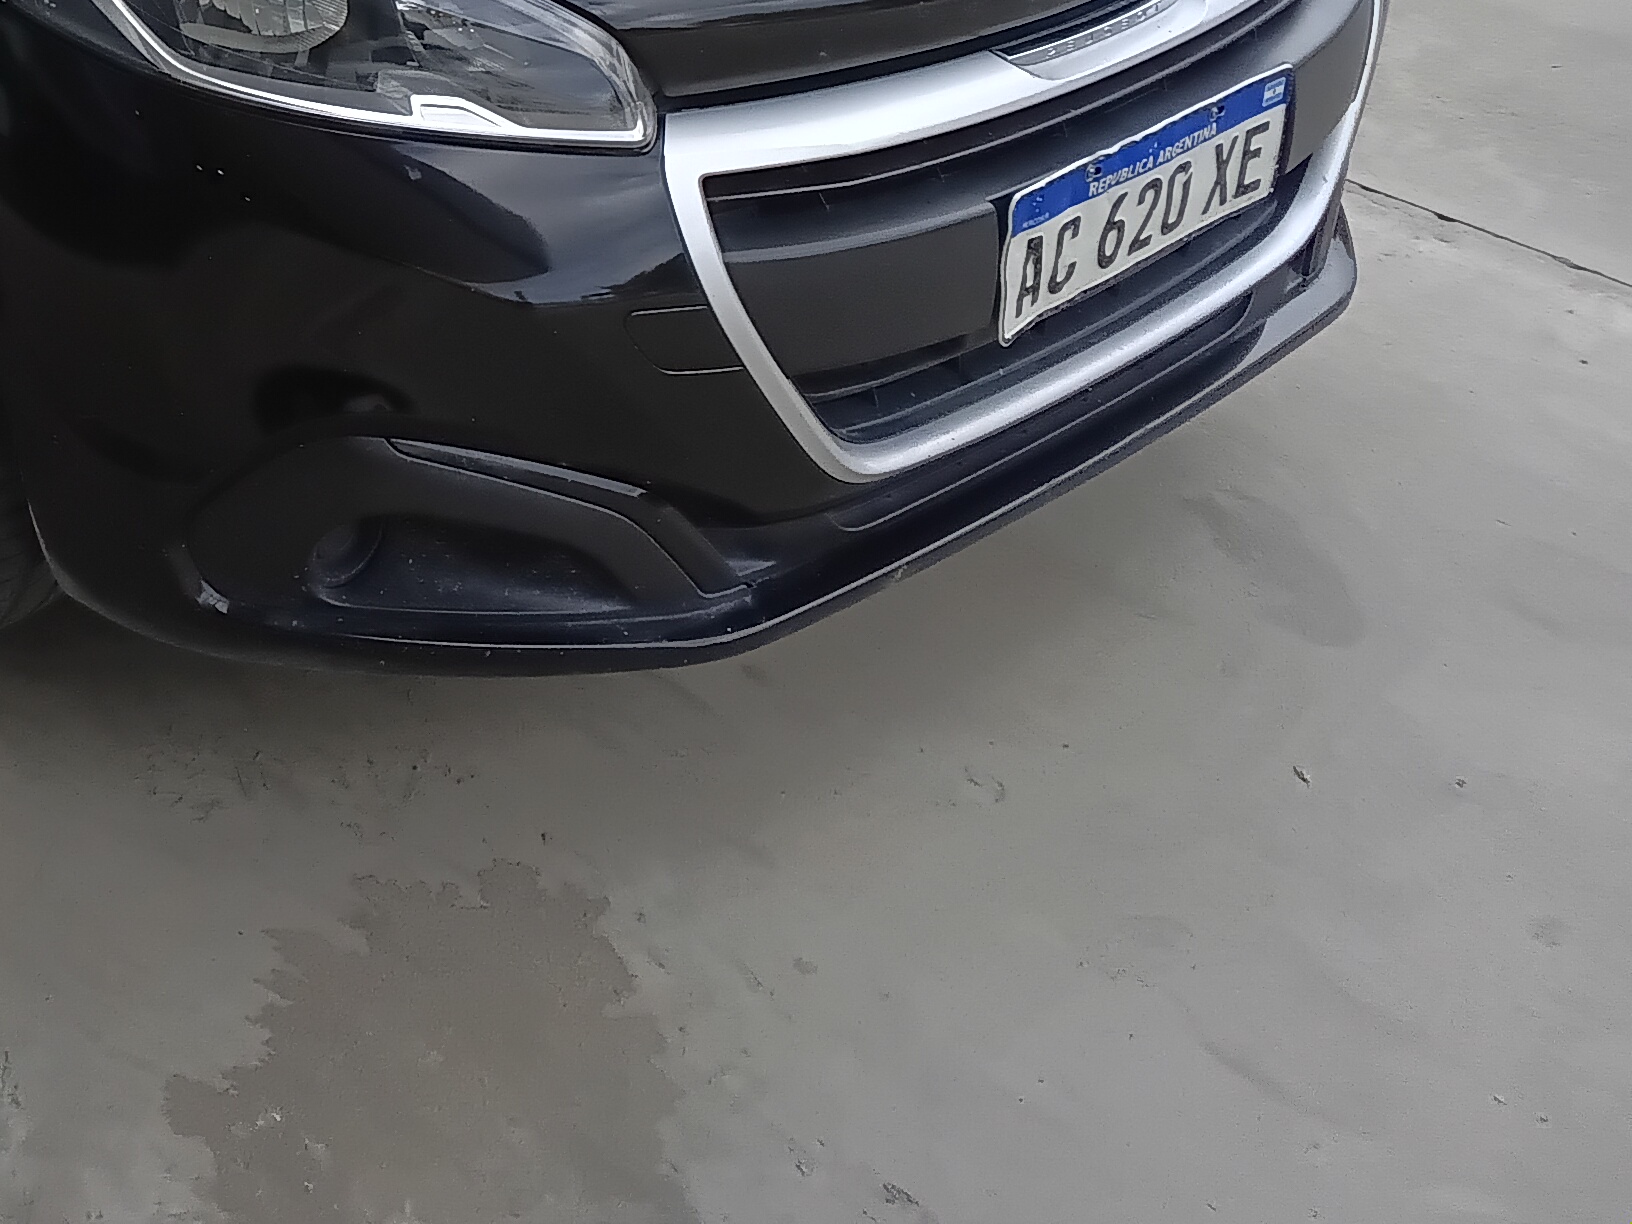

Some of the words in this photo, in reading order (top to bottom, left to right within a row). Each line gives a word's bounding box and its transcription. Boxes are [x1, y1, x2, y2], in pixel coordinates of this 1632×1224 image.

[1156, 122, 1218, 164] ARGENTINA
[1015, 215, 1082, 319] AC
[1097, 160, 1194, 270] 620
[1201, 120, 1271, 216] XE
